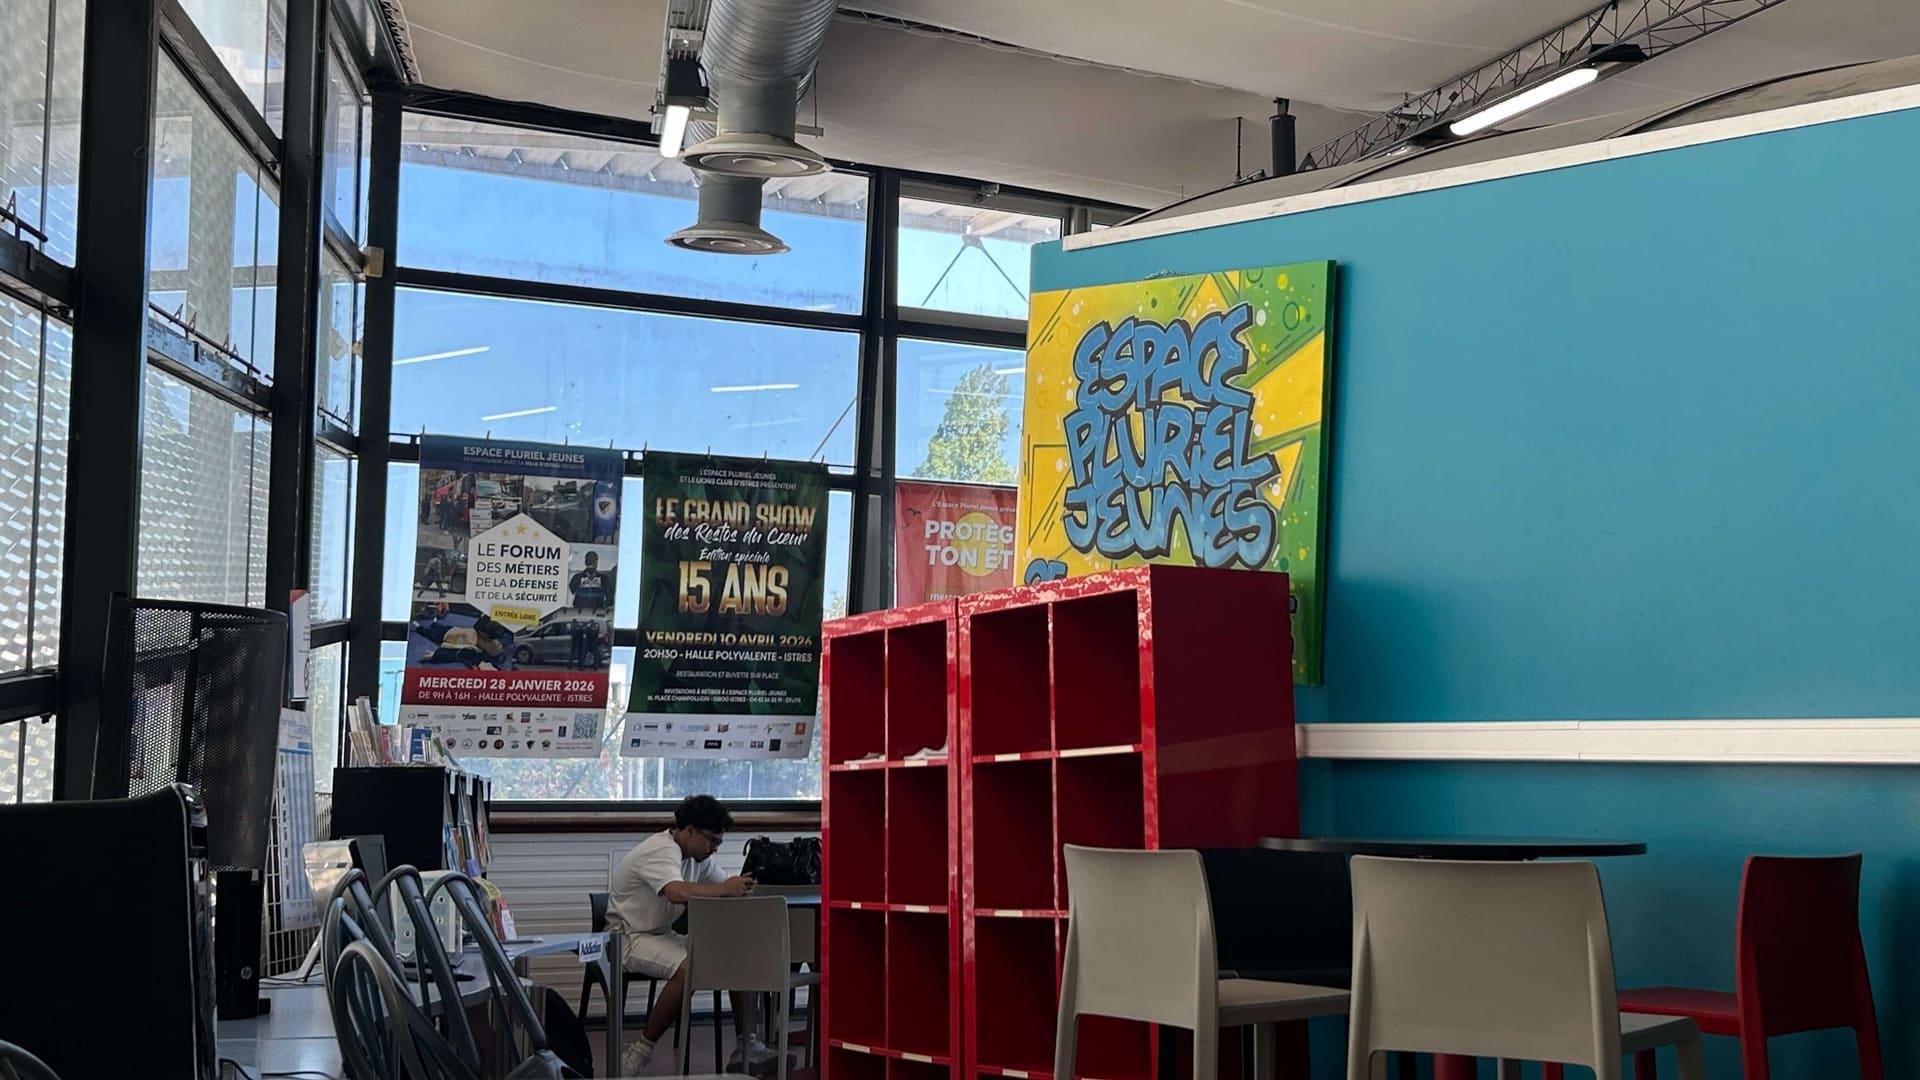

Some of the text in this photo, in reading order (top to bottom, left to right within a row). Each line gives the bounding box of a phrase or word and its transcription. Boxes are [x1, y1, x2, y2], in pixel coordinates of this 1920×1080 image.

[1073, 301, 1254, 411] ESPACE
[1064, 404, 1281, 489] PLURIEL
[464, 446, 502, 458] ESPACE
[504, 449, 545, 460] PLURIEL
[547, 452, 585, 464] JEUNES
[728, 471, 752, 479] PLURIEL
[656, 496, 816, 534] LE GRAND SHOW
[1063, 481, 1276, 568] JEUNES
[664, 523, 690, 541] des
[694, 523, 737, 544] Restos
[742, 526, 762, 544] du
[478, 543, 561, 560] LE FORUM
[925, 544, 978, 567] TON
[476, 561, 560, 576] DES MÉTIERS
[476, 577, 558, 590] DE LA DÉFENSE
[678, 560, 789, 616] 15 ANS
[475, 590, 558, 602] ET DE LA SÉCURITÉ
[494, 610, 518, 619] ENTRÉE
[646, 631, 812, 647] VENDREDI 10 AVRIL 2026
[644, 649, 678, 659] 20H30
[685, 650, 713, 660] HALLE
[715, 651, 777, 662] POLYVALENTE
[784, 652, 812, 663] ISTRES
[750, 671, 761, 679] SUR
[762, 672, 779, 680] PLACE
[419, 677, 595, 691] MERCREDI 28 JANVIER 2026
[418, 691, 431, 700] DE
[432, 691, 444, 700] 9H
[445, 690, 452, 700] À
[454, 692, 470, 700] 16H
[478, 692, 504, 701] HALLE
[506, 693, 561, 702] POLYVALENTE
[567, 694, 593, 703] ISTRES
